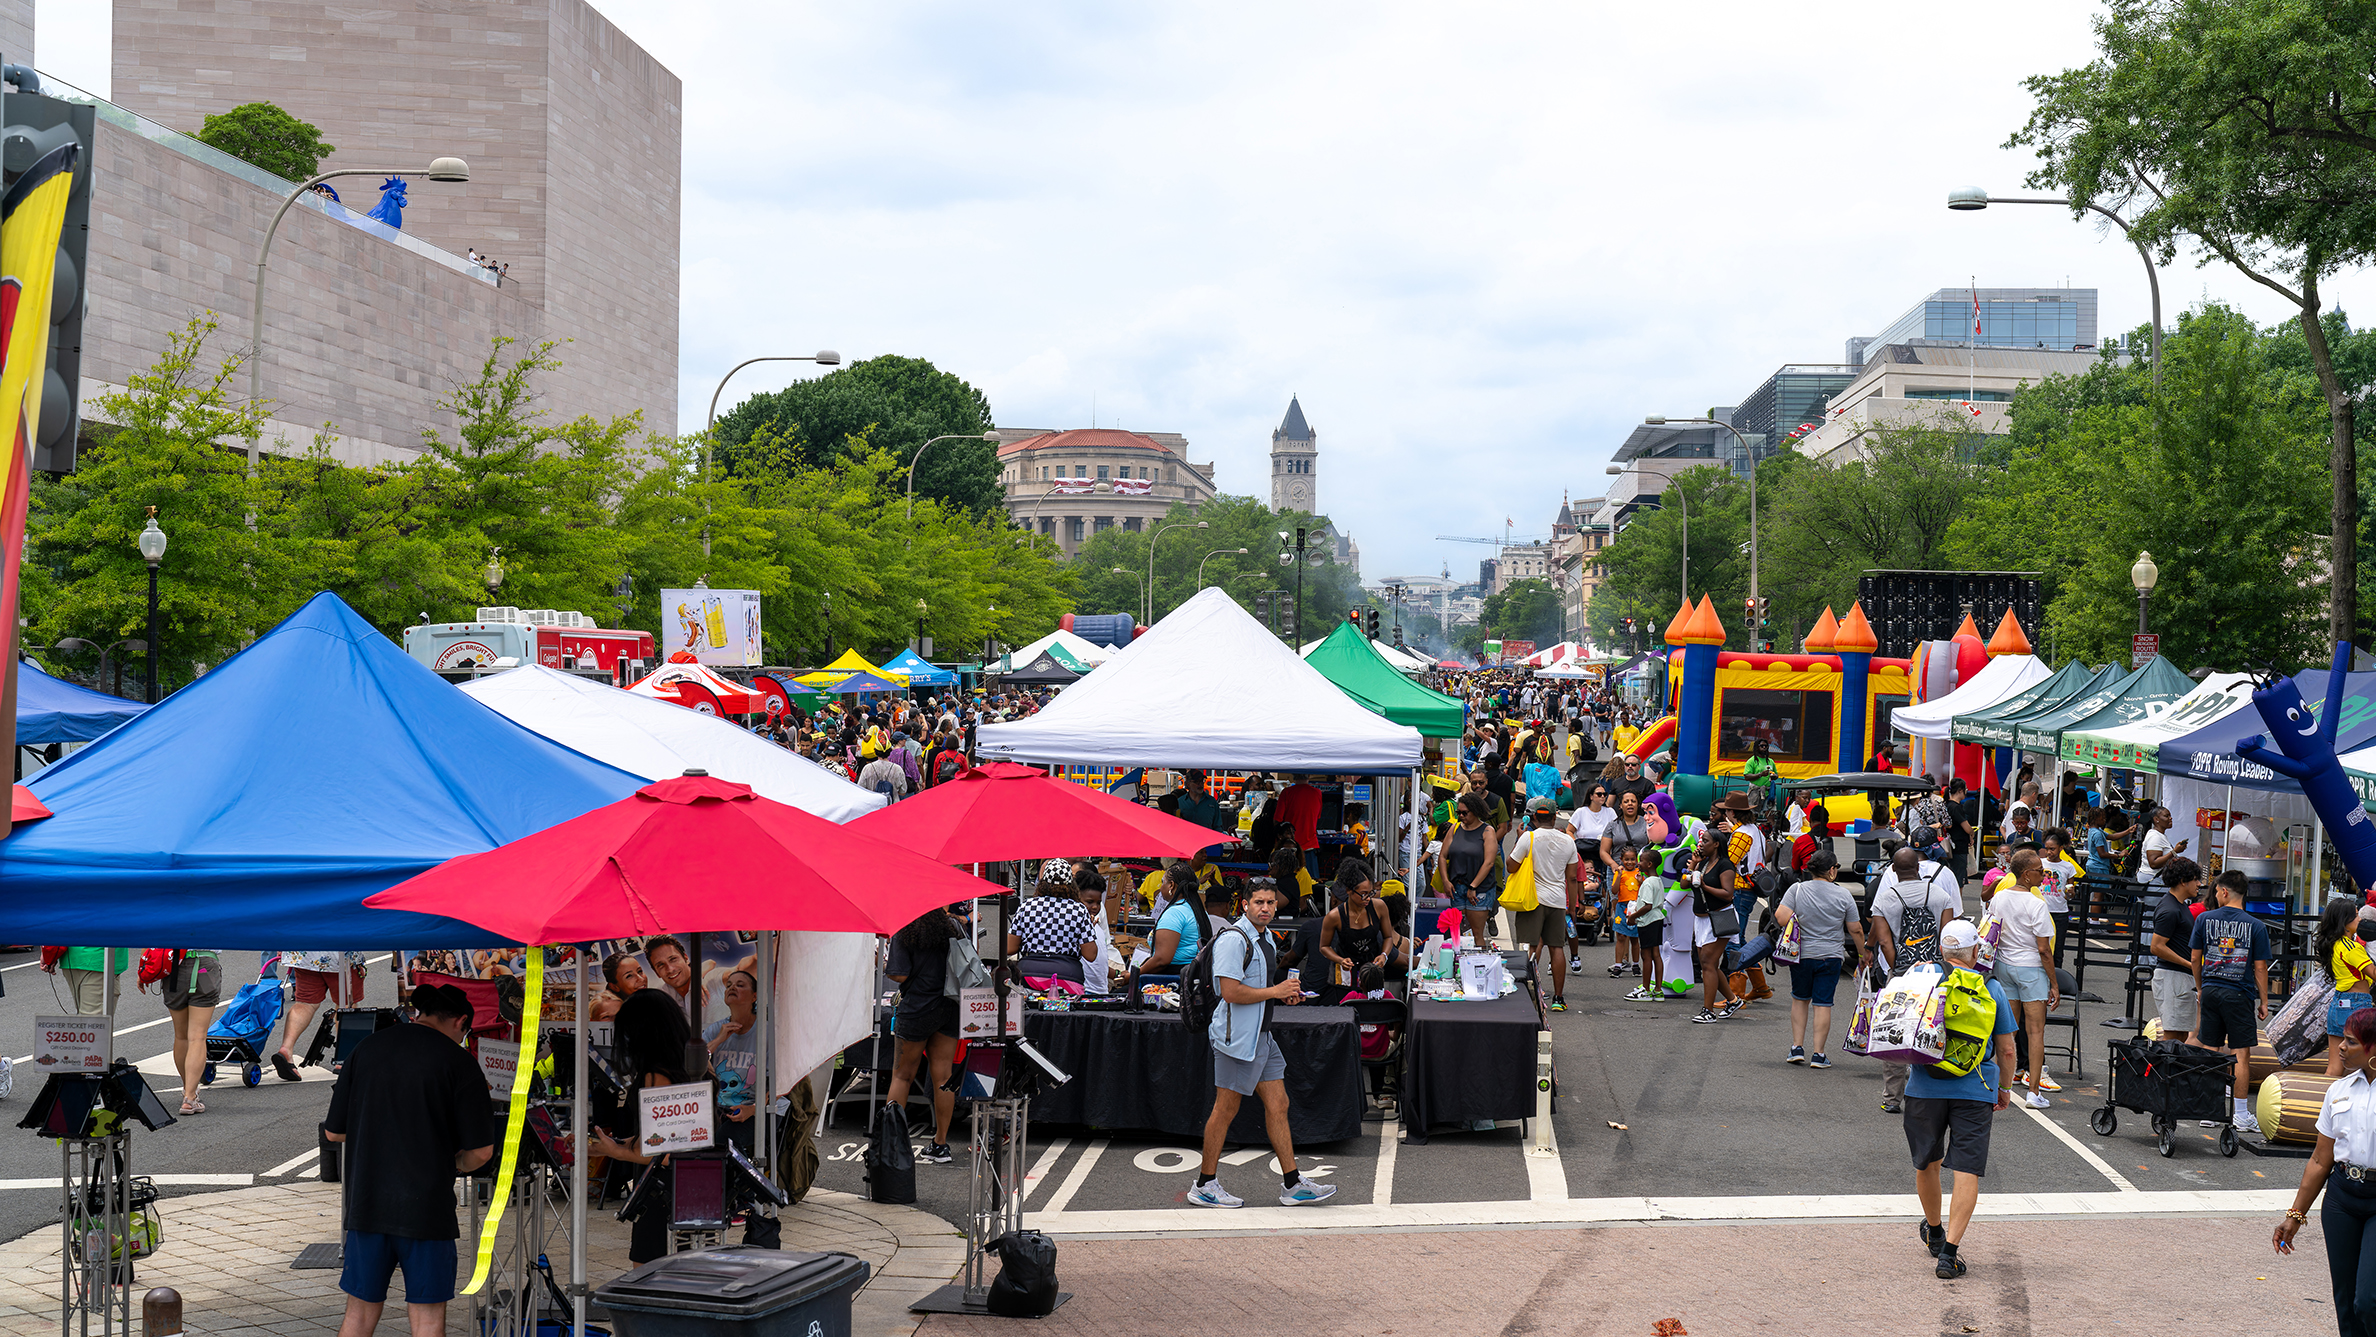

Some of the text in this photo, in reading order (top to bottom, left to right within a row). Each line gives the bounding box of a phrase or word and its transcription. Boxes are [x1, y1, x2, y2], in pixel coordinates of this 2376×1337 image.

[910, 674, 931, 682] RRY'S
[2195, 752, 2212, 772] DPR
[2213, 755, 2239, 780] Roving
[2214, 920, 2252, 947] BARCELONA
[970, 1002, 1010, 1013] $250.0
[46, 1030, 95, 1044] $250.00
[480, 1046, 497, 1054] REGISTER
[485, 1056, 516, 1072] $250.00
[643, 1094, 670, 1104] REGISTER
[652, 1102, 699, 1121] $250.00
[690, 1128, 708, 1136] PAPA
